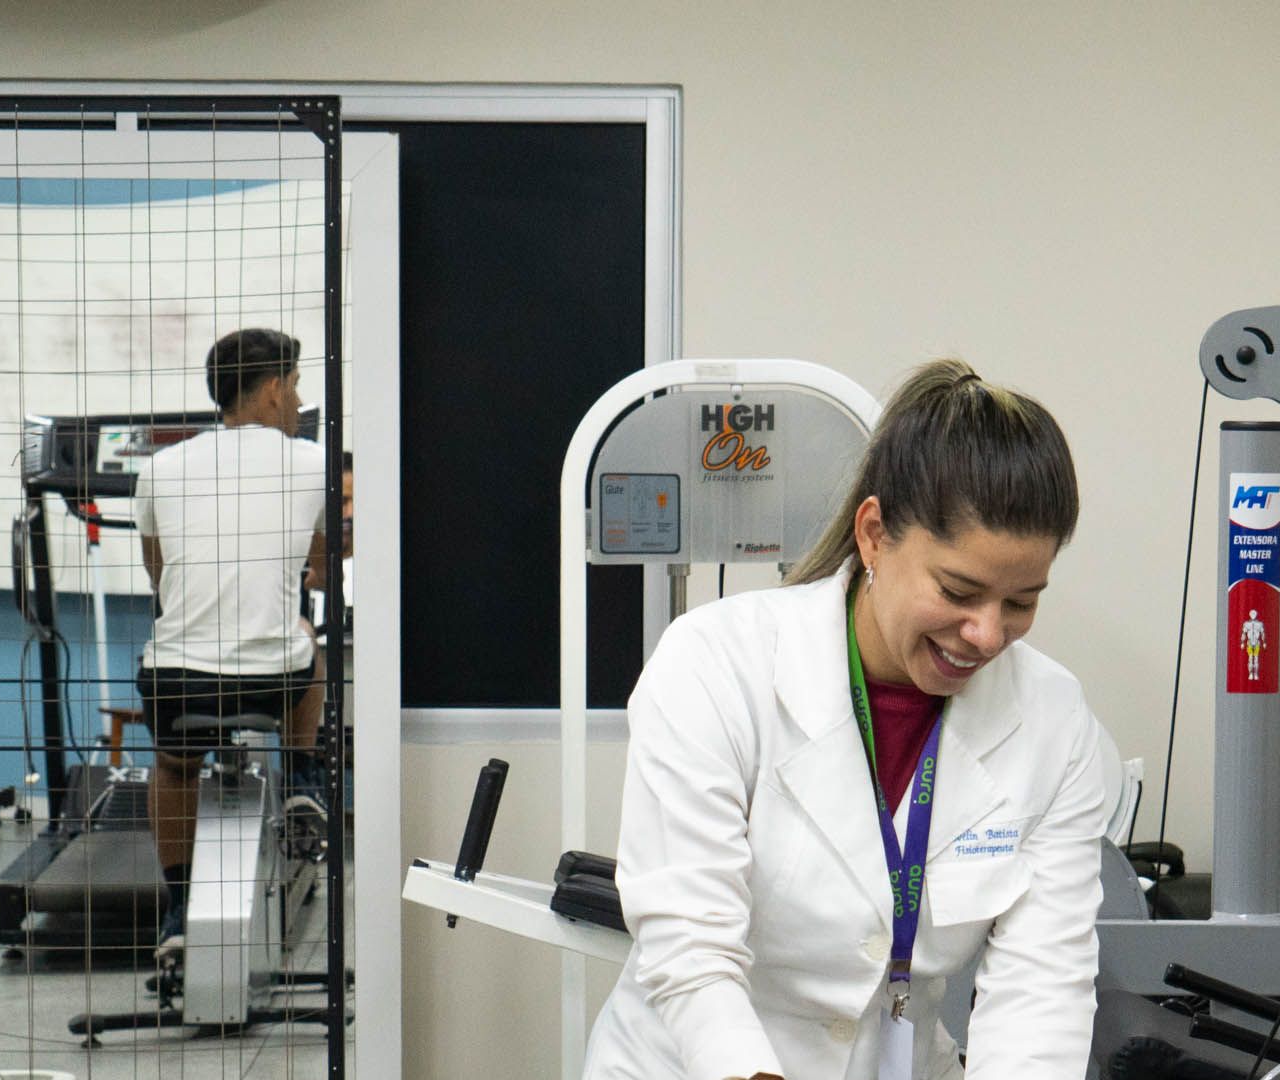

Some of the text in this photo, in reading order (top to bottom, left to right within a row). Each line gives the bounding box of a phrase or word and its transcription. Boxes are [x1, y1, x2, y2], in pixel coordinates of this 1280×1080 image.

[701, 403, 775, 431] HIGH
[702, 431, 771, 471] On
[1232, 486, 1280, 508] MAT
[1233, 535, 1278, 545] EXTENSORA
[1239, 549, 1271, 559] MASTER
[1245, 564, 1264, 574] LINE
[985, 828, 1019, 840] Batista
